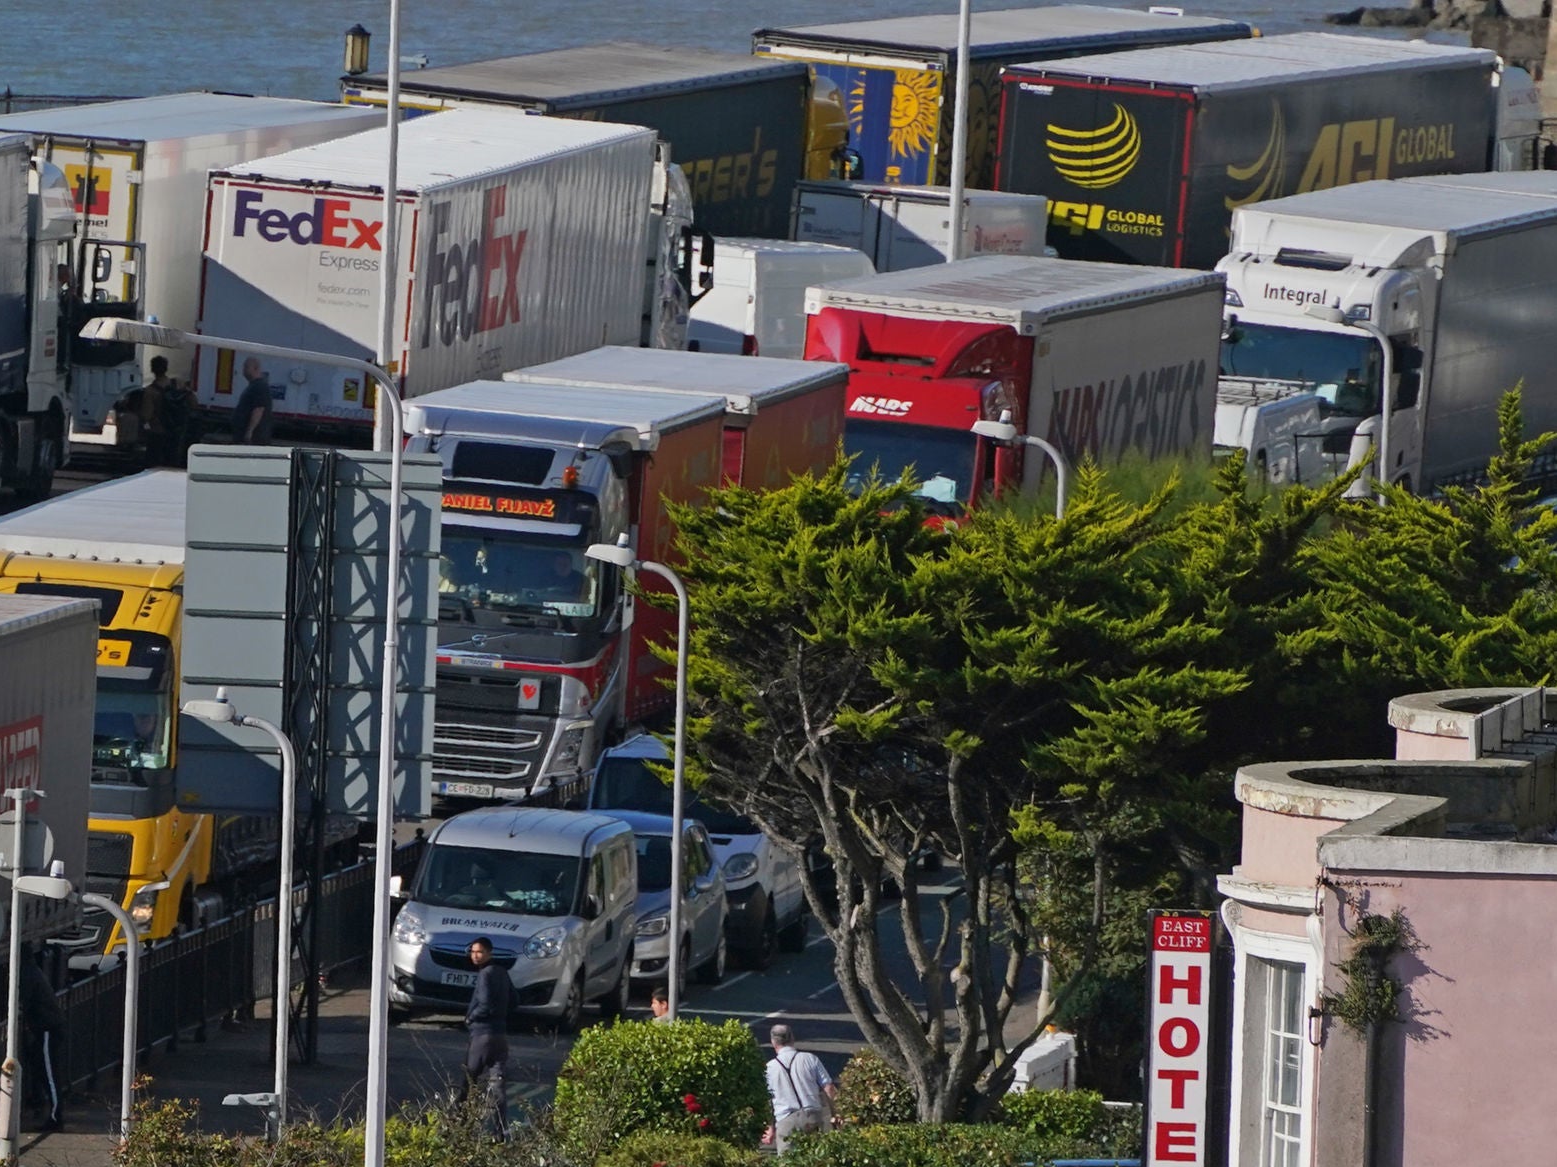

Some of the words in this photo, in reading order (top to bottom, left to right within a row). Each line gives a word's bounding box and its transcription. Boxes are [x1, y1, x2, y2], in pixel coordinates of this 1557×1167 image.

[1395, 123, 1456, 165] GLOBAL
[233, 190, 384, 252] FedEx
[1106, 209, 1165, 226] GLOBAL
[1106, 222, 1163, 237] LOGISTICS
[319, 250, 380, 271] Express
[421, 184, 529, 349] FedEx
[1264, 283, 1327, 306] Integral
[849, 395, 914, 416] MARS
[442, 493, 492, 511] ANIEL
[1162, 921, 1203, 933] EAST
[1158, 935, 1206, 948] CLIFF
